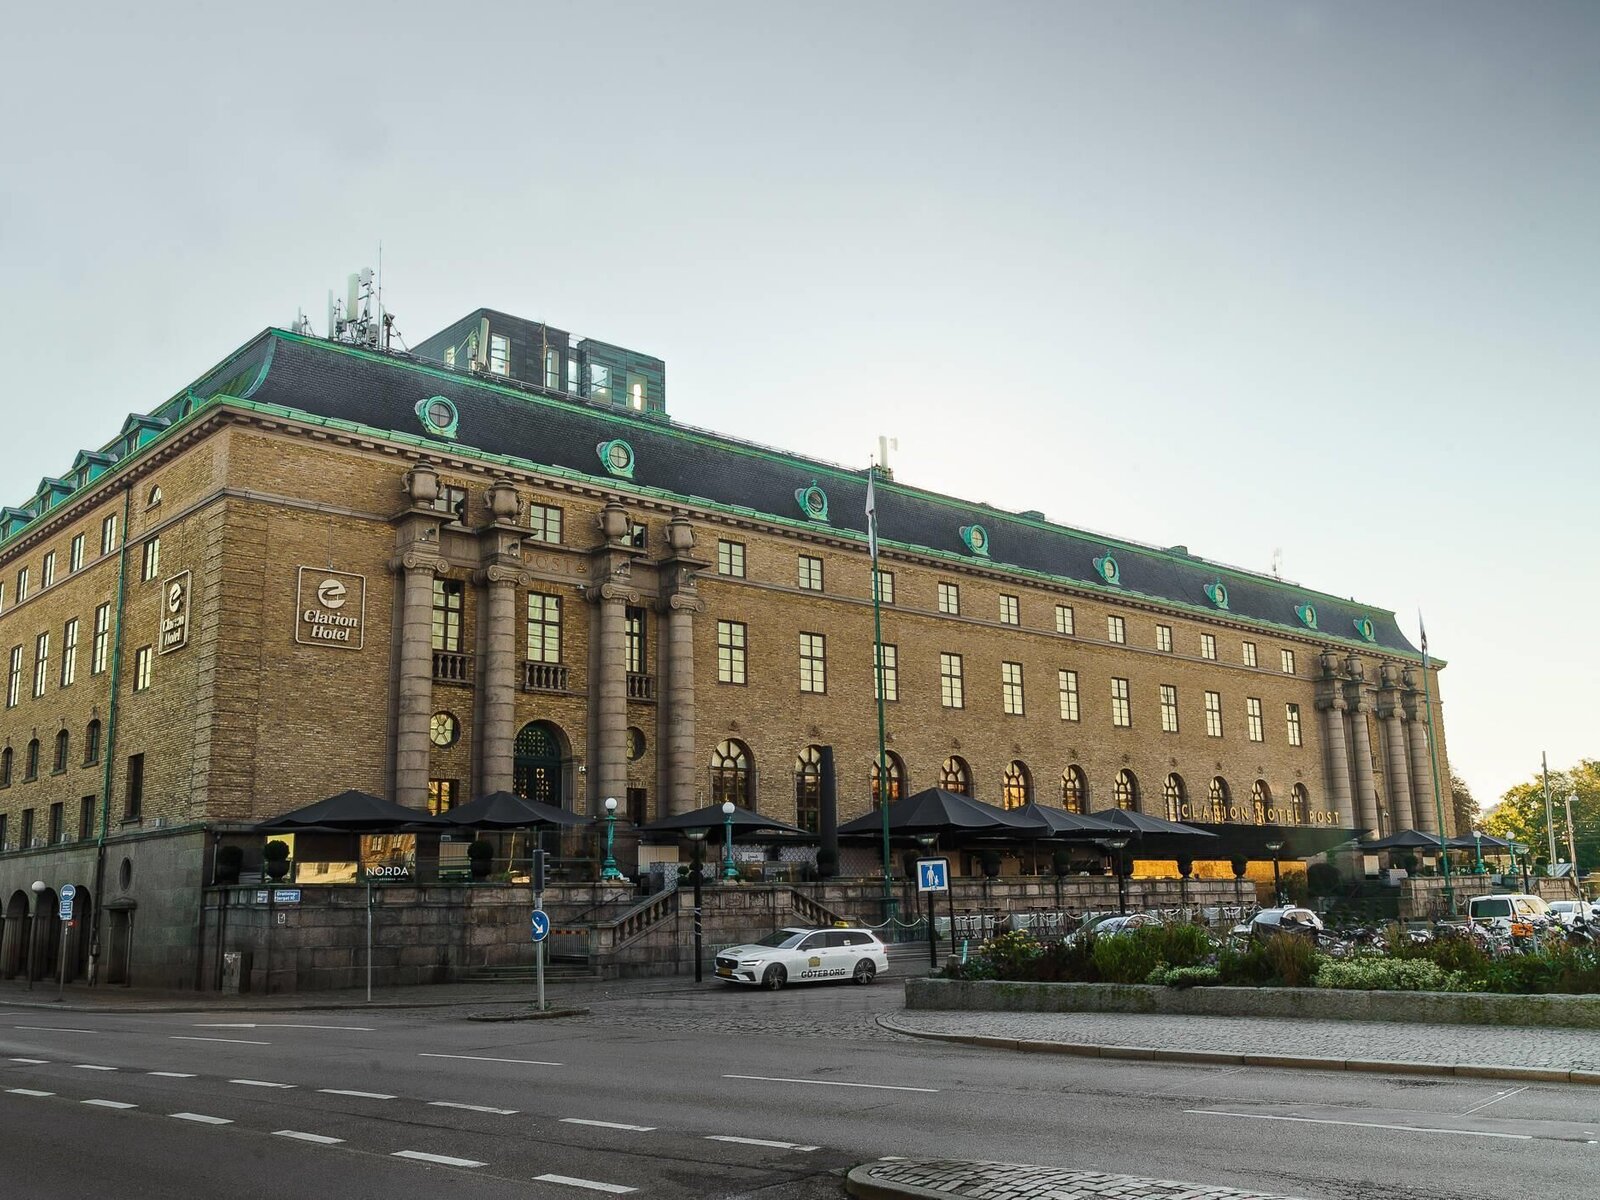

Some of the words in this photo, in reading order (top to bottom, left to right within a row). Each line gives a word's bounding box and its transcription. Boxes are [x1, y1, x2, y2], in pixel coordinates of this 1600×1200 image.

[303, 609, 358, 627] Clarion
[311, 624, 350, 641] Hotel
[1181, 804, 1249, 821] CLARION
[1255, 806, 1301, 823] HOTEL
[1308, 810, 1340, 824] POST
[366, 866, 409, 876] NORDA
[801, 968, 846, 978] GÖTEBORG
